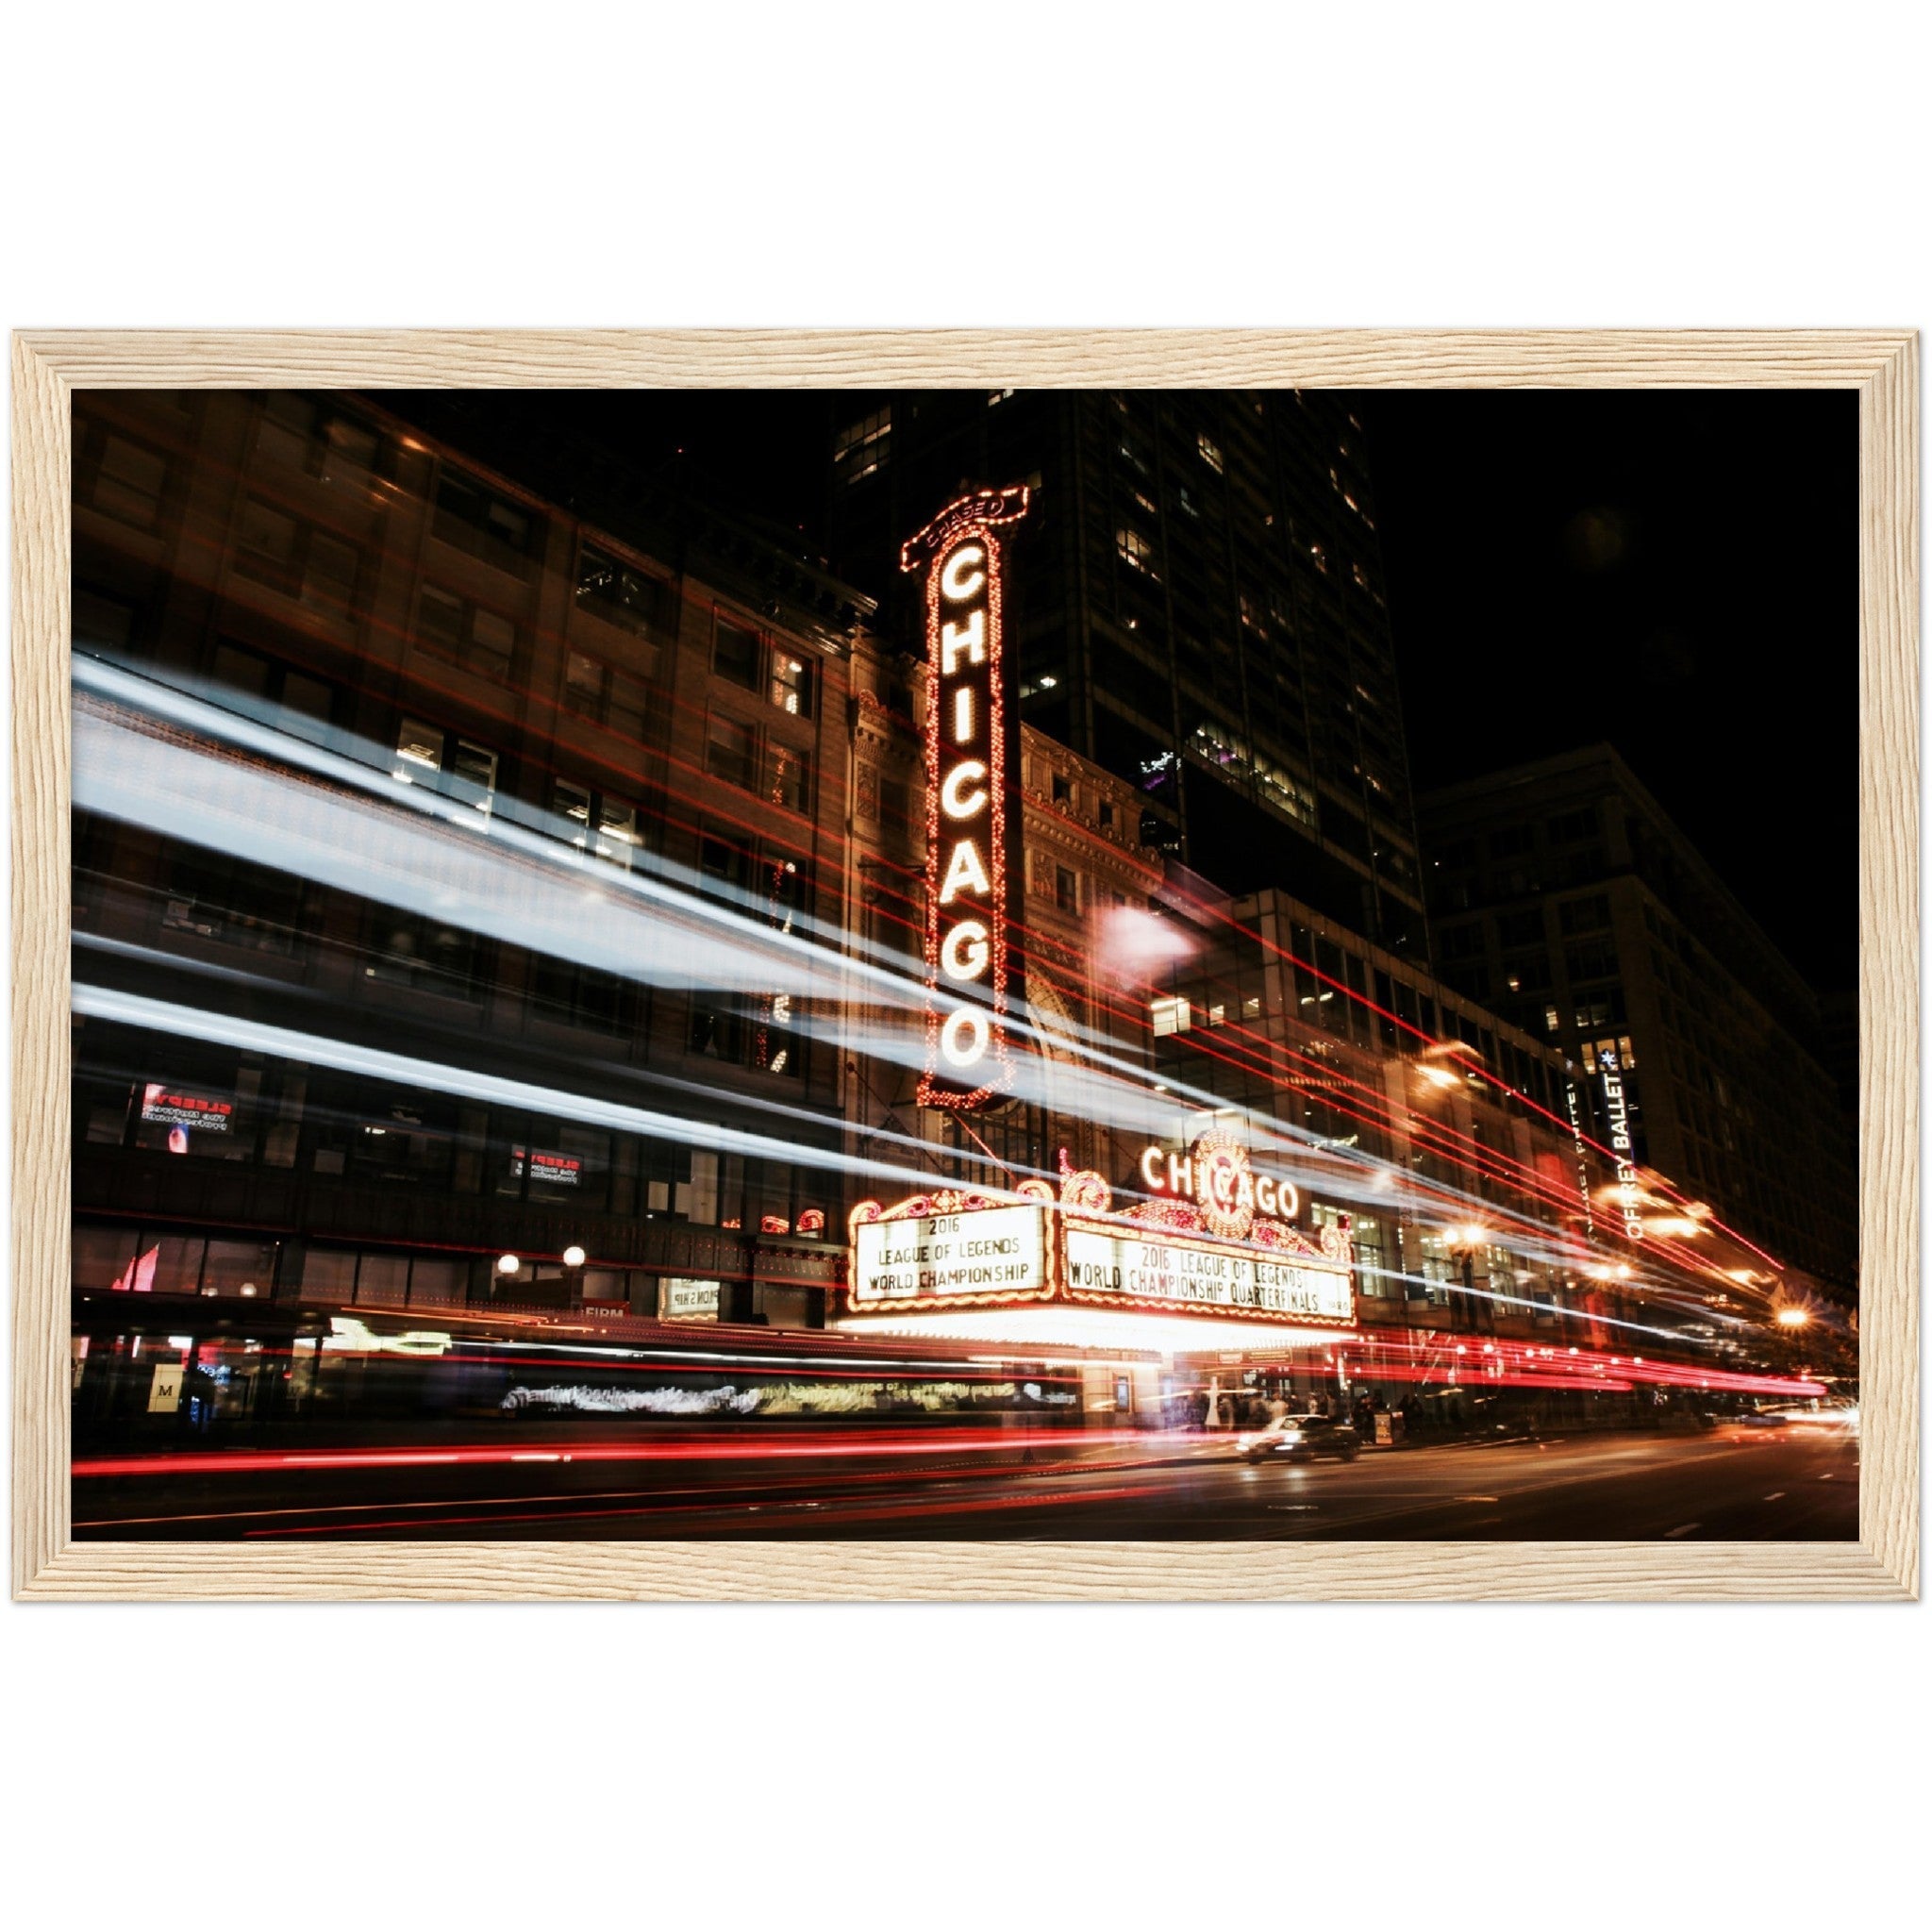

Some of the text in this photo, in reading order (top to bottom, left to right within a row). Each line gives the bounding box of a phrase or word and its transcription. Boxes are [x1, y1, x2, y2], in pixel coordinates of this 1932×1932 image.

[939, 545, 991, 1068] CHICAGO
[1605, 1073, 1631, 1150] BALLET
[1141, 1145, 1299, 1218] CHICAGO
[928, 1217, 960, 1236] 2016
[878, 1237, 1020, 1266] LEAGUE OF LEGENDS
[1141, 1246, 1303, 1289] 2016 LEAGUE OF LEGENDS
[869, 1262, 1029, 1291] WORLD CHAMPIONSHIP
[1070, 1260, 1319, 1312] WORLD CHAMPIONSHIP QUARTERFINALS
[158, 1385, 173, 1396] M
